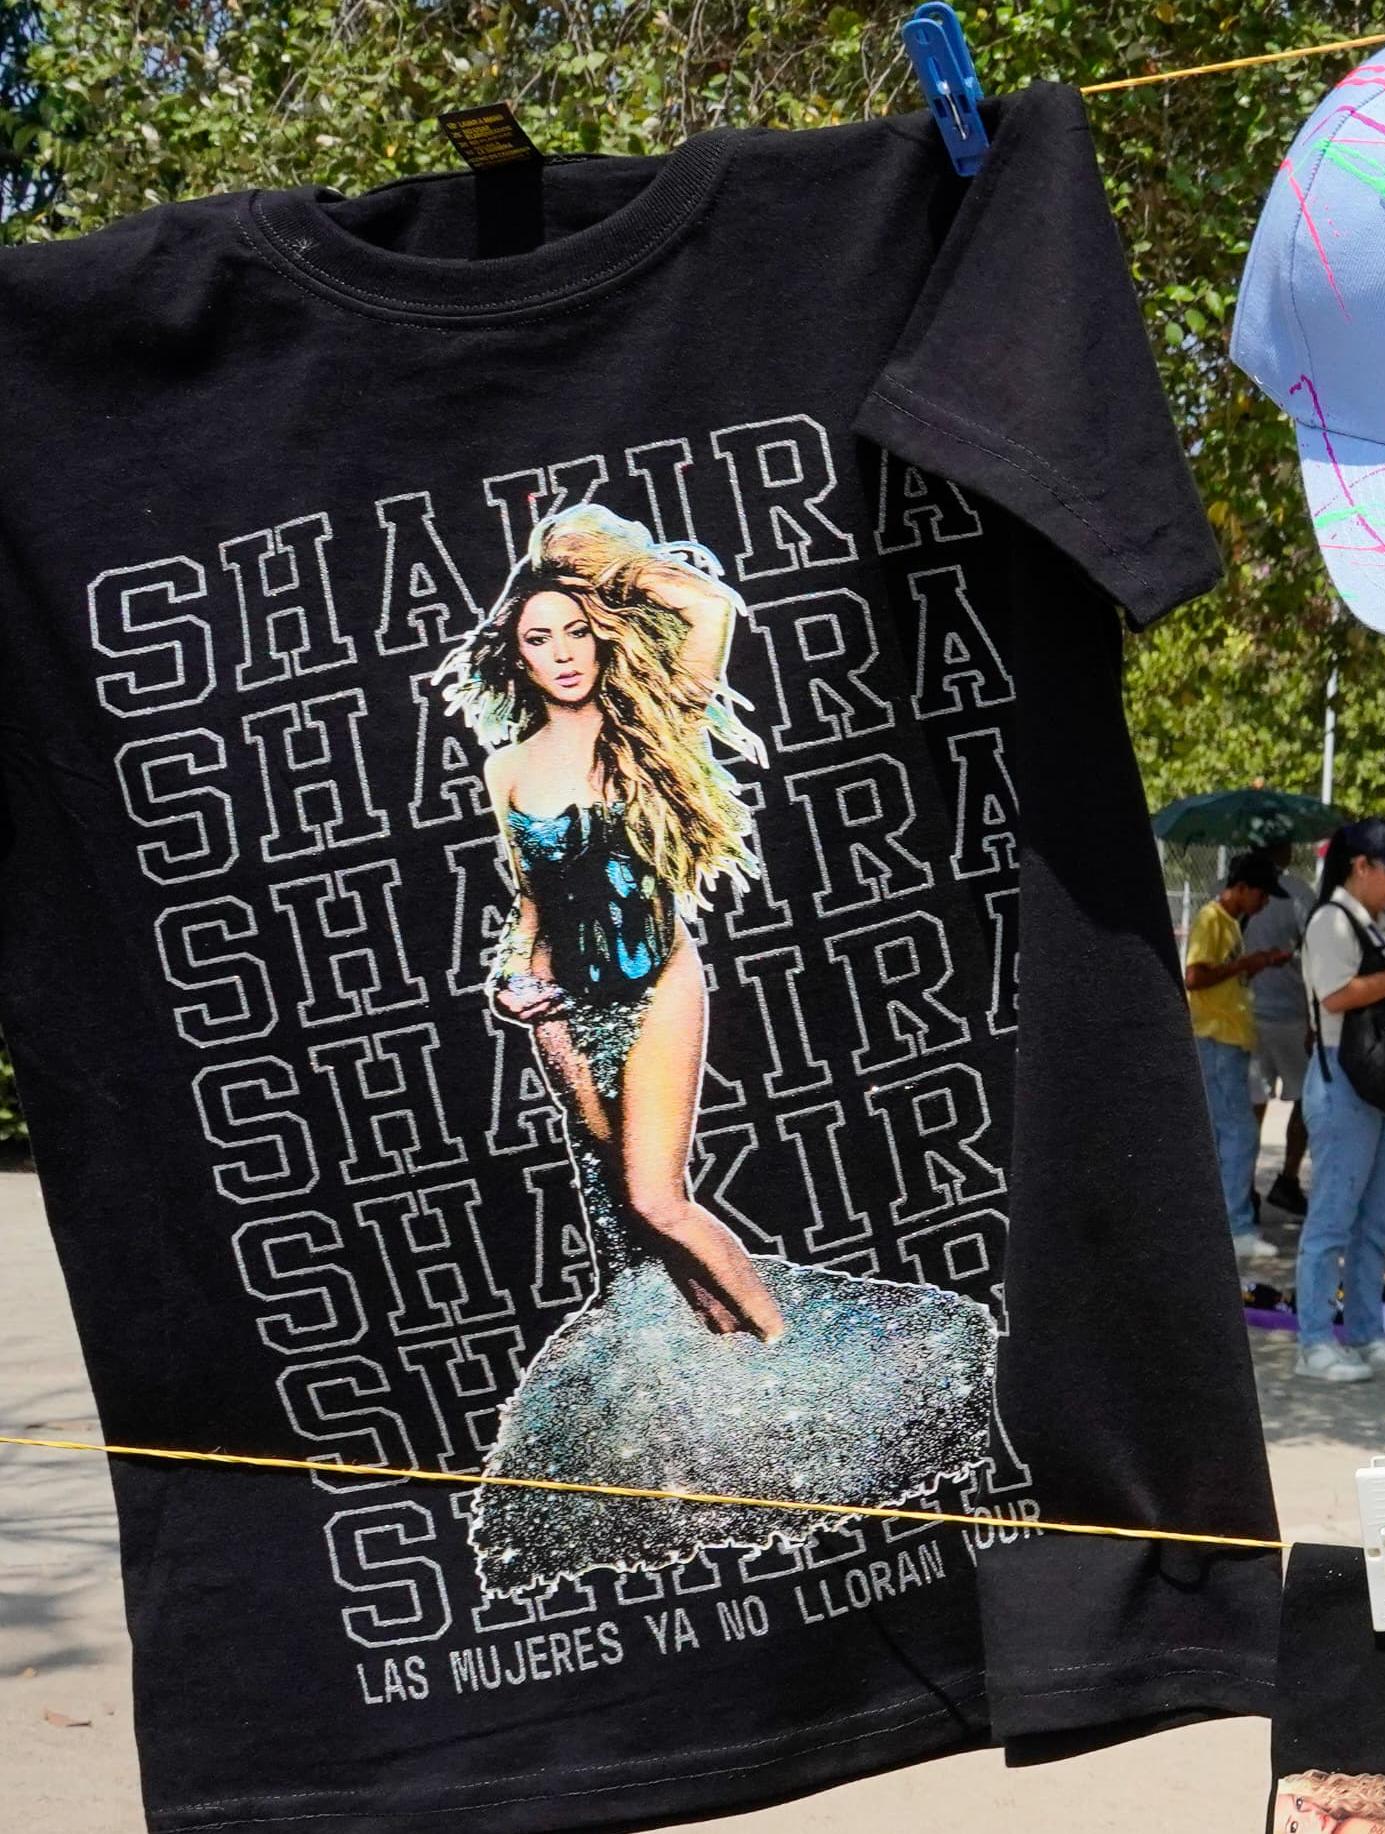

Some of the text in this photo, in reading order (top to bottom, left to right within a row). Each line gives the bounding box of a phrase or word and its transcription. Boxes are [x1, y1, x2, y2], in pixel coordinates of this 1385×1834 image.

[114, 565, 1016, 885] SHARA
[154, 728, 1020, 1048] SHAIRA
[356, 1655, 430, 1705] LAS
[449, 1621, 624, 1695] MUJERES
[644, 1606, 700, 1655] YA
[715, 1594, 769, 1643] NO
[793, 1540, 946, 1625] LLORAN
